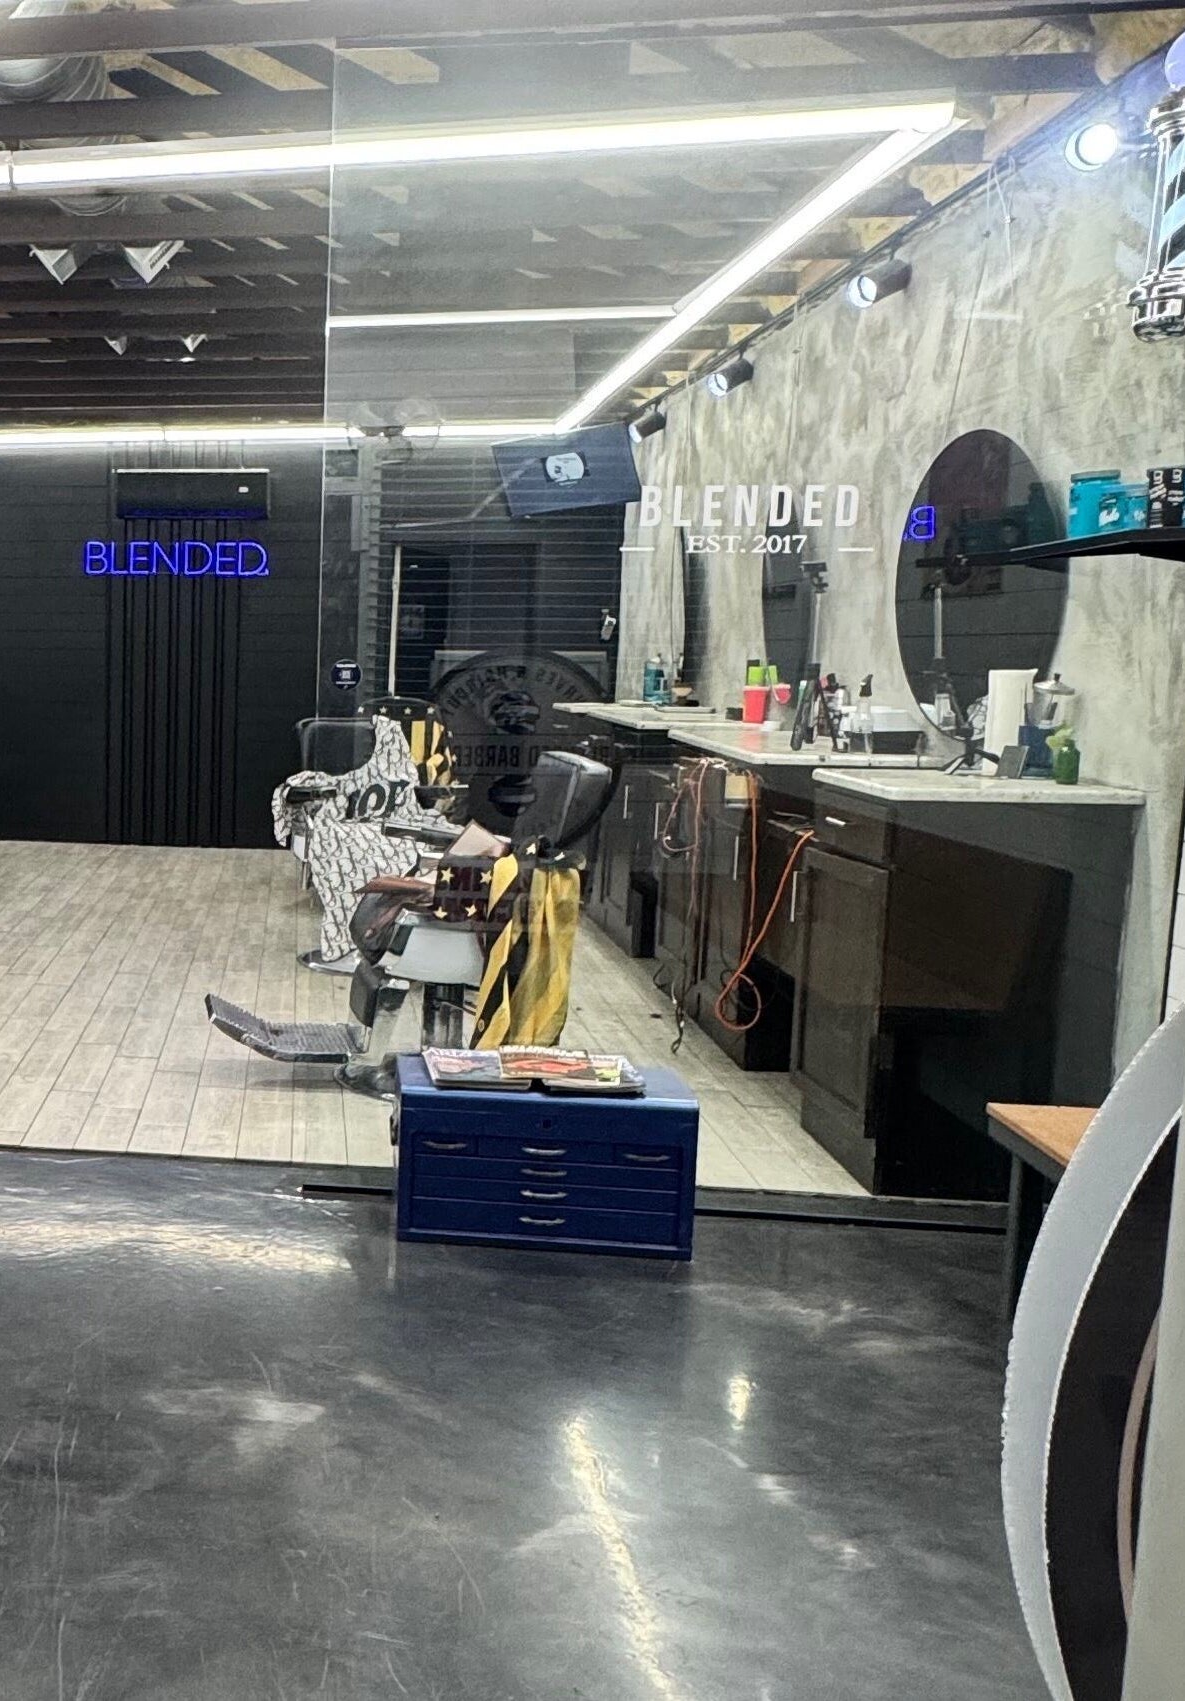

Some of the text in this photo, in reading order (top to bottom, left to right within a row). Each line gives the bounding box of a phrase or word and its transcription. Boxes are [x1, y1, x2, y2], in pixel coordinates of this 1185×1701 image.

[640, 484, 861, 528] BLENDED
[686, 534, 808, 555] EST. 2017
